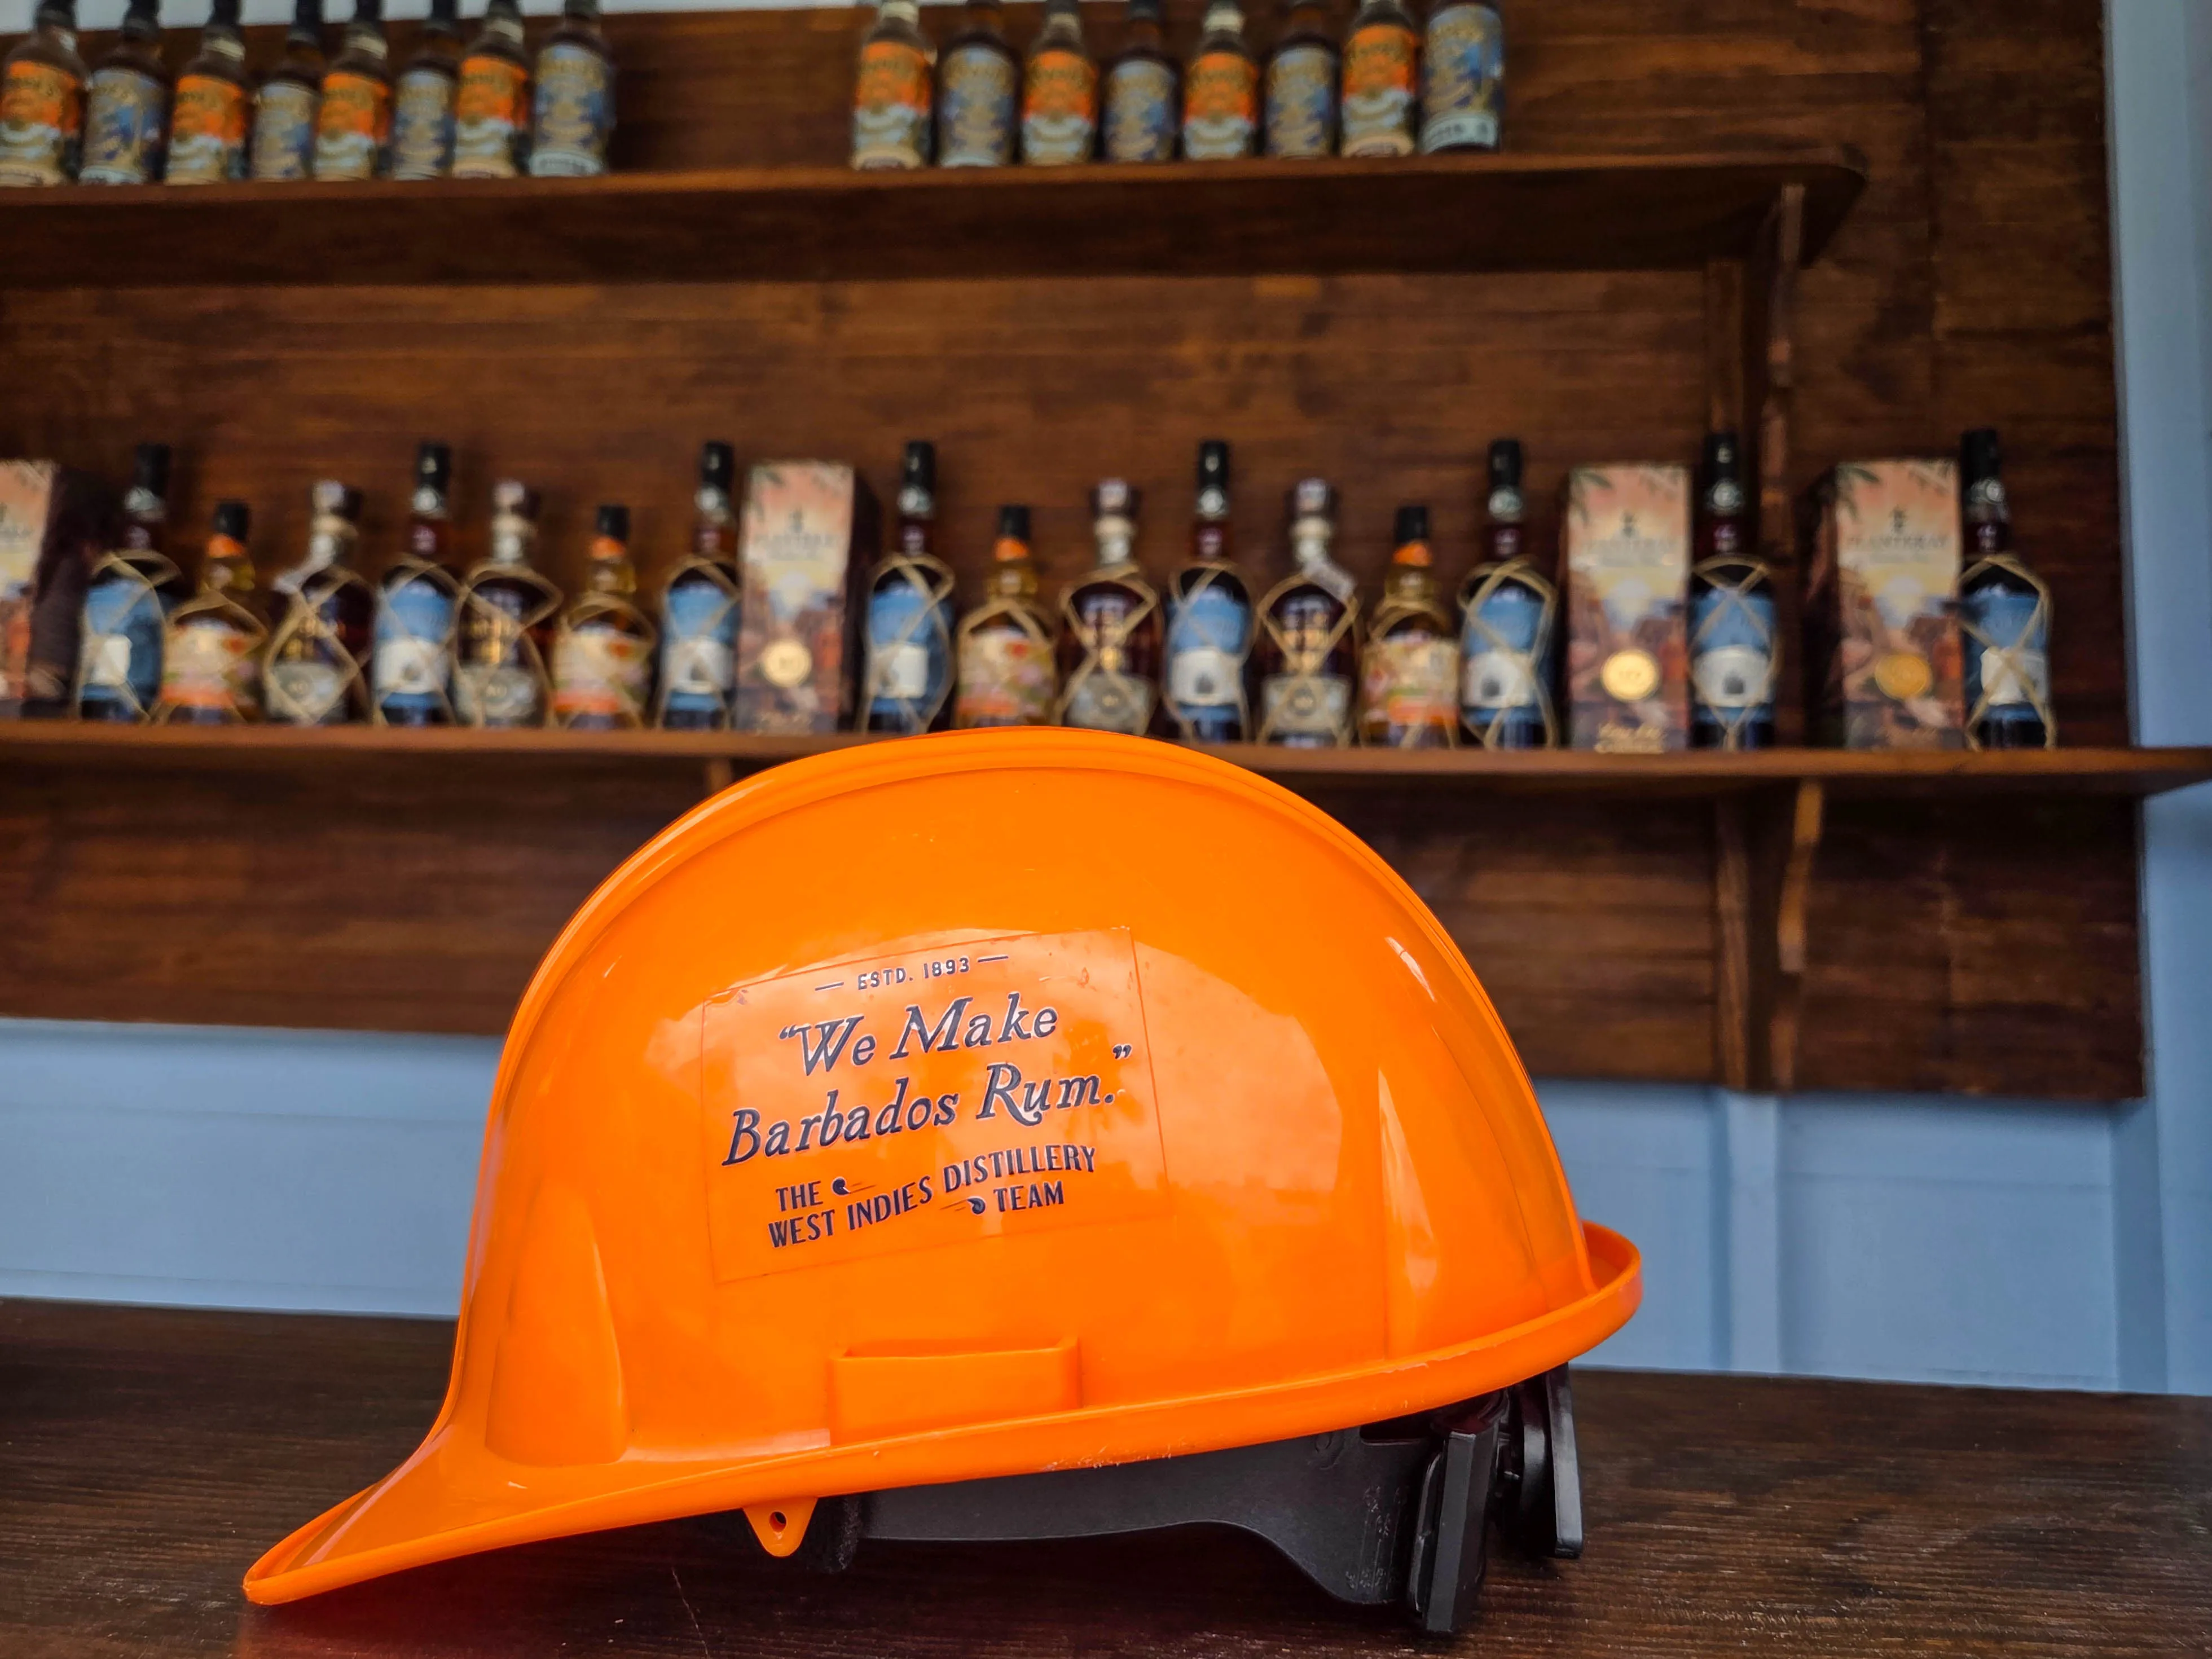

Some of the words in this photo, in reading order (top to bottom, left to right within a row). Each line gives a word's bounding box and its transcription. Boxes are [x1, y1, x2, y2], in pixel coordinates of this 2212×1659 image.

[857, 966, 914, 990] ESTD.
[923, 956, 970, 979] 1893
[889, 992, 1058, 1059] Make
[722, 1077, 959, 1166] Barbados
[768, 1209, 835, 1248] WEST
[847, 1176, 932, 1231] INDIES
[943, 1145, 1096, 1192] DISTILLERY
[775, 1181, 822, 1212] THE
[993, 1181, 1064, 1212] TEAM
